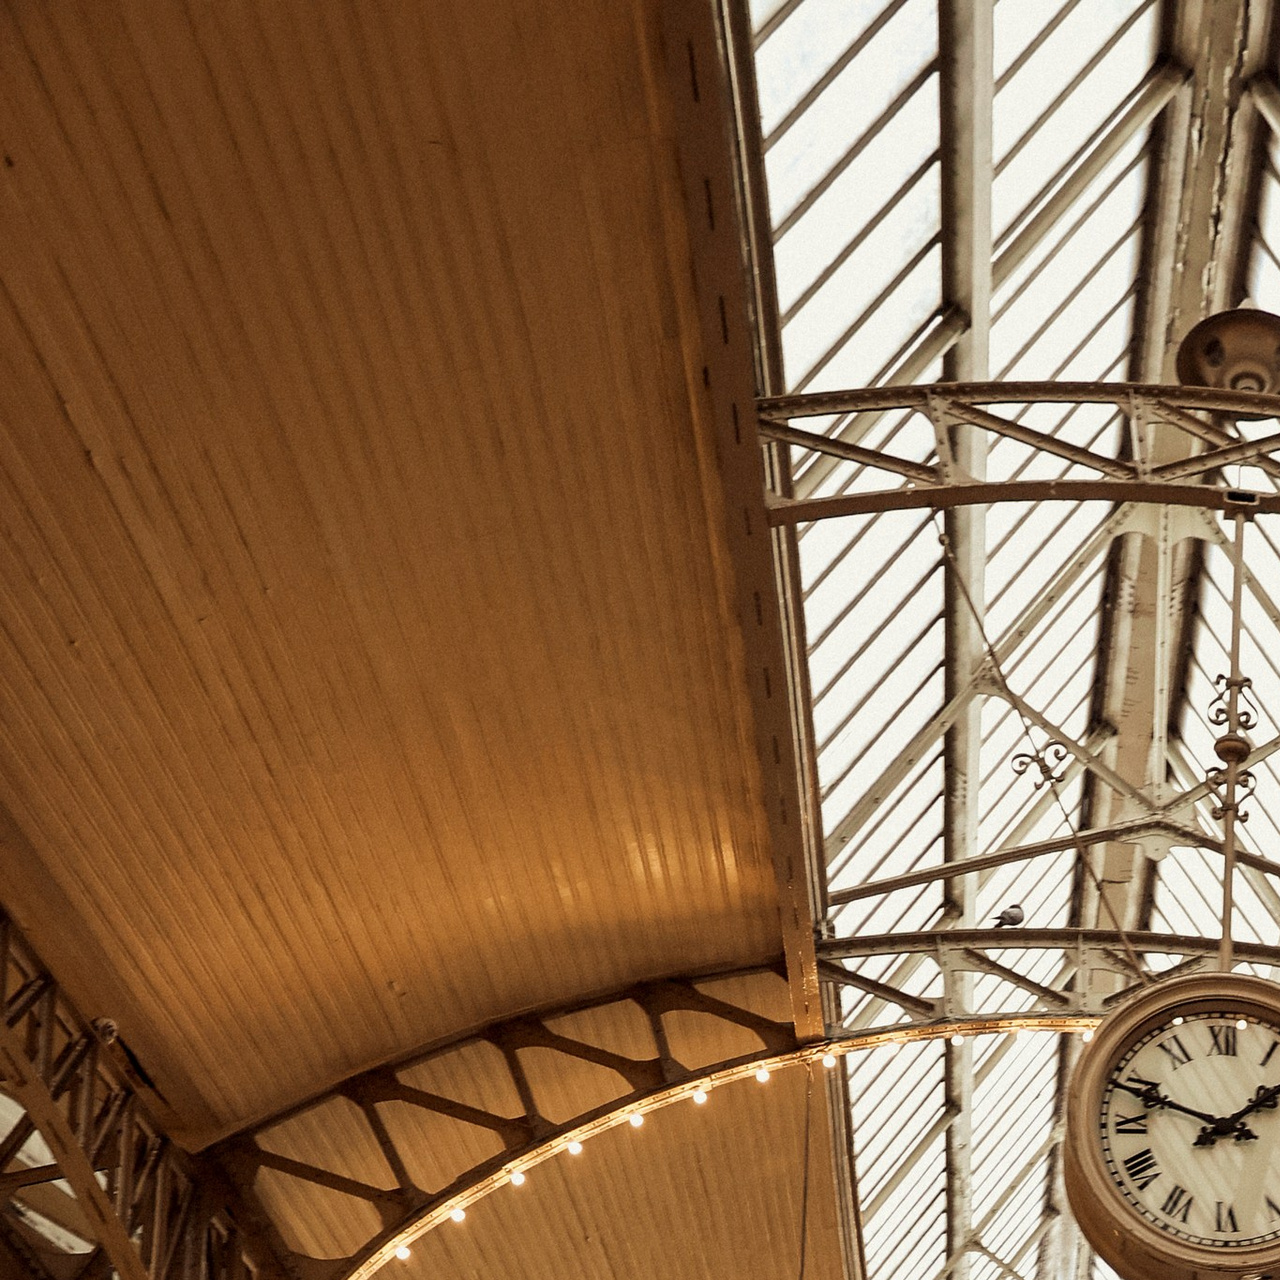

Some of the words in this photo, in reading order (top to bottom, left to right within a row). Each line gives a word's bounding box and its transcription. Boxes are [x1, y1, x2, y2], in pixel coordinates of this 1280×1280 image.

[1157, 1035, 1194, 1071] XI
[1207, 1026, 1238, 1056] XII
[1260, 1041, 1280, 1067] I
[1115, 1114, 1147, 1134] IX
[1124, 1148, 1162, 1190] VIII
[1161, 1186, 1194, 1224] VII
[1215, 1201, 1240, 1233] VI
